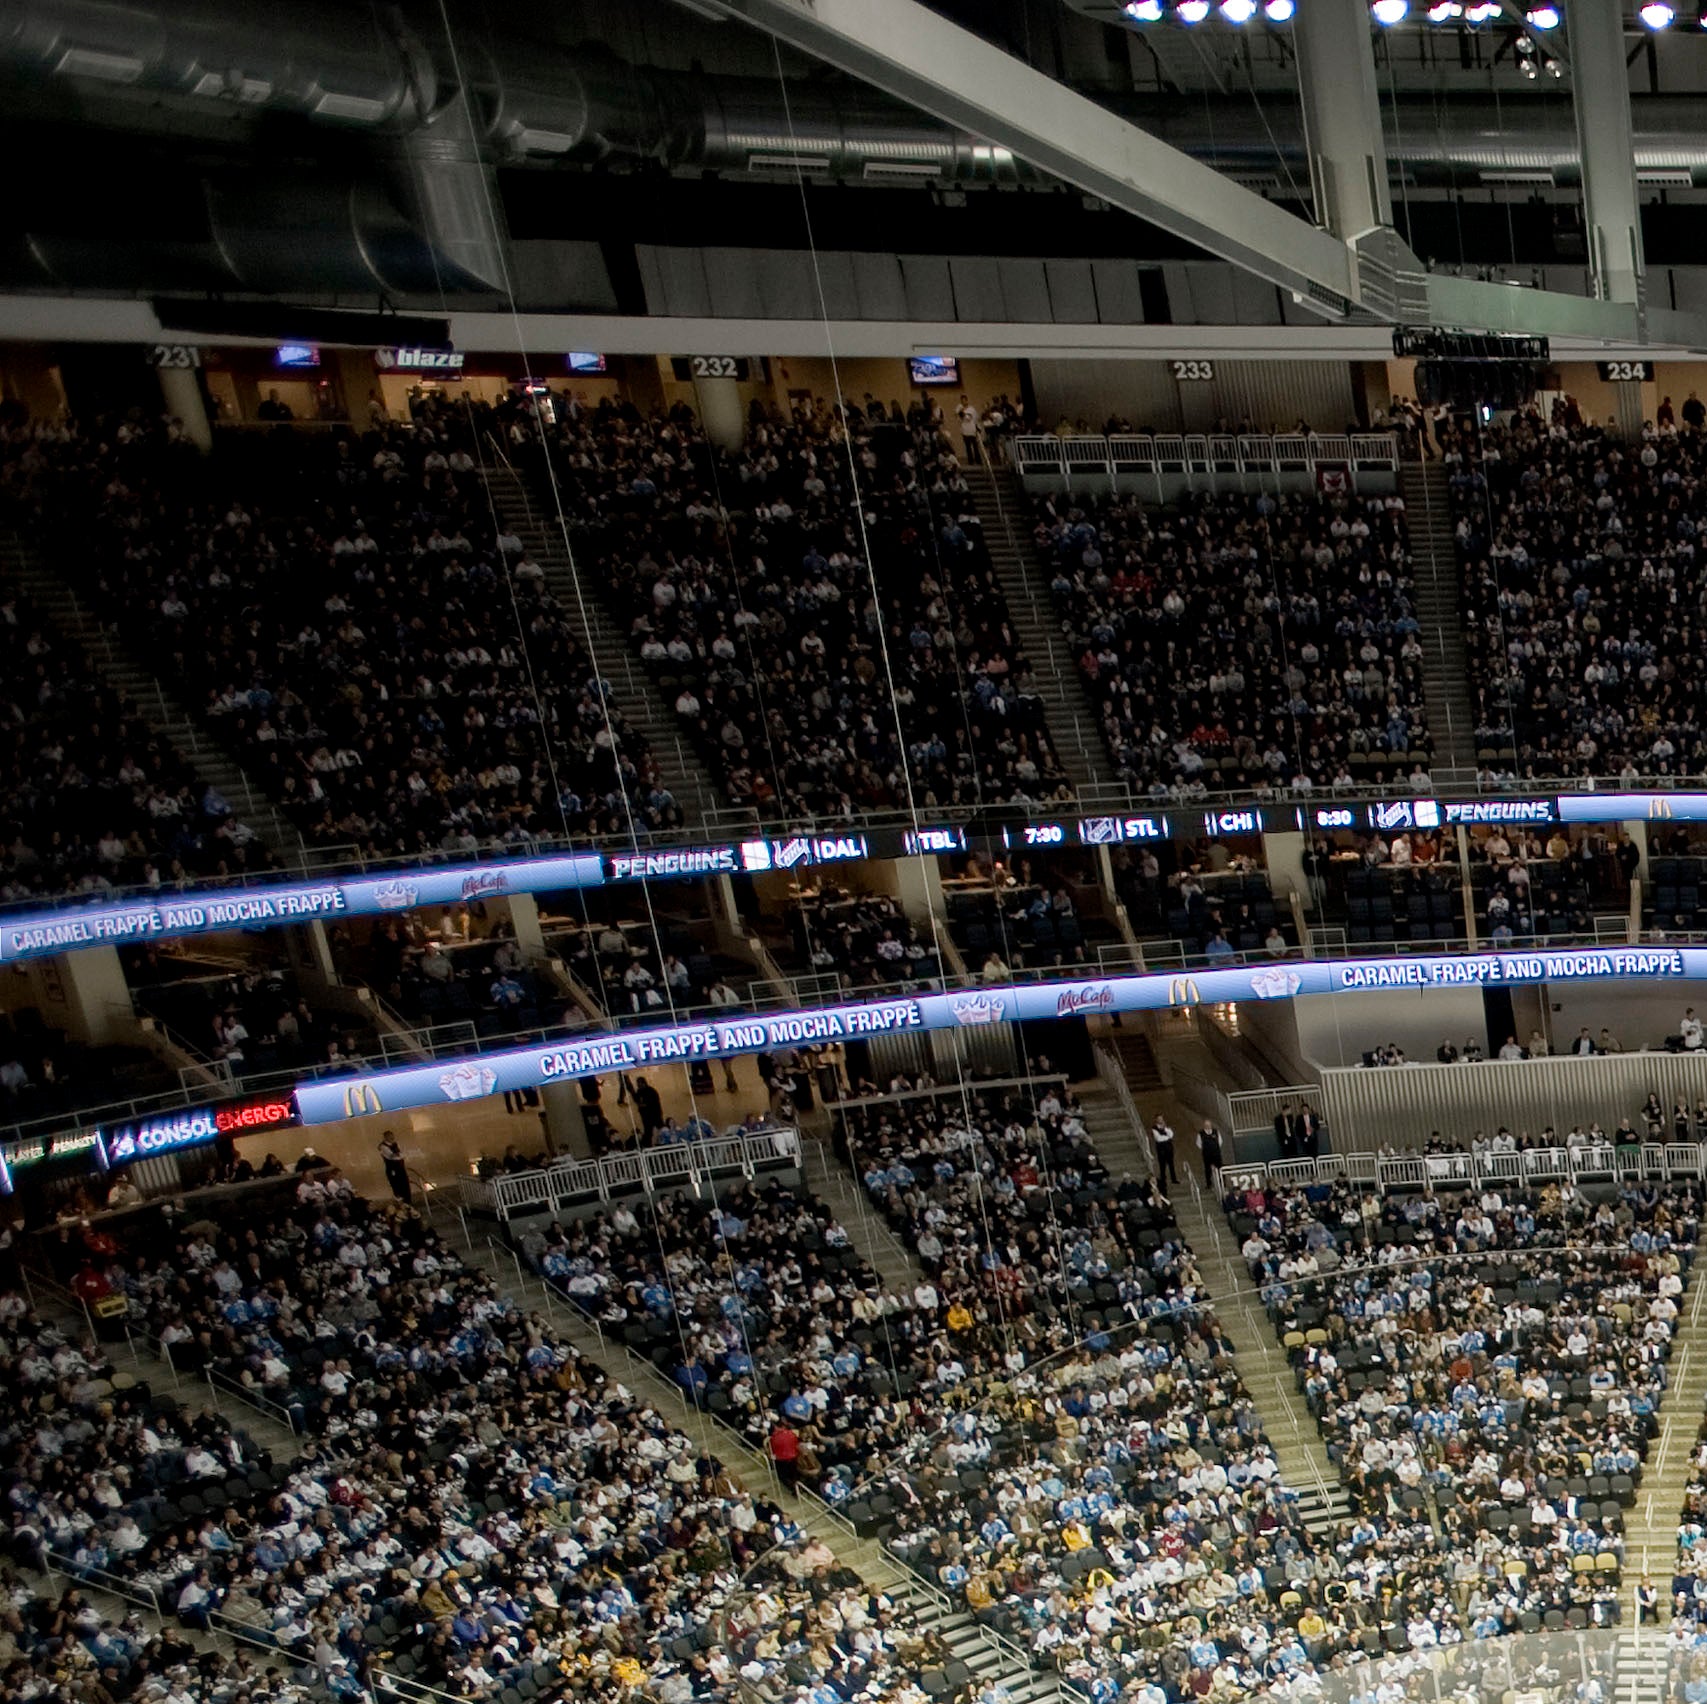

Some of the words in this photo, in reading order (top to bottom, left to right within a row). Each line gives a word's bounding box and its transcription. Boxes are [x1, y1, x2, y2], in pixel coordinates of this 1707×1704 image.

[397, 347, 465, 368] blaze
[694, 357, 736, 378] 232
[1173, 360, 1213, 381] 233
[1607, 362, 1646, 381] 234
[1219, 813, 1255, 832] CHI
[1317, 809, 1352, 826] 8:30
[1024, 826, 1063, 844] 7:30
[1125, 818, 1159, 838] STL
[821, 840, 862, 860] DAL
[918, 830, 957, 850] TBL
[11, 921, 92, 953] CARAMEL
[95, 909, 163, 938] FRAPPÉ
[166, 907, 206, 929] AND
[209, 896, 275, 924] MOCHA
[276, 886, 345, 917] FRAPPÉ
[1341, 965, 1428, 988] CARAMEL
[1432, 956, 1501, 983] FRAPPÉ
[1505, 958, 1543, 979] AND
[1547, 956, 1611, 977] MOCHA
[1615, 947, 1682, 973] FRAPPÉ
[538, 1038, 636, 1078] CARAMEL
[640, 1027, 719, 1061] FRAPPÉ
[723, 1024, 766, 1049] AND
[769, 1013, 845, 1045] MOCHA
[846, 1000, 922, 1034] FRAPPÉ
[137, 1117, 219, 1152] CONSOL
[1229, 1173, 1259, 1189] 121
